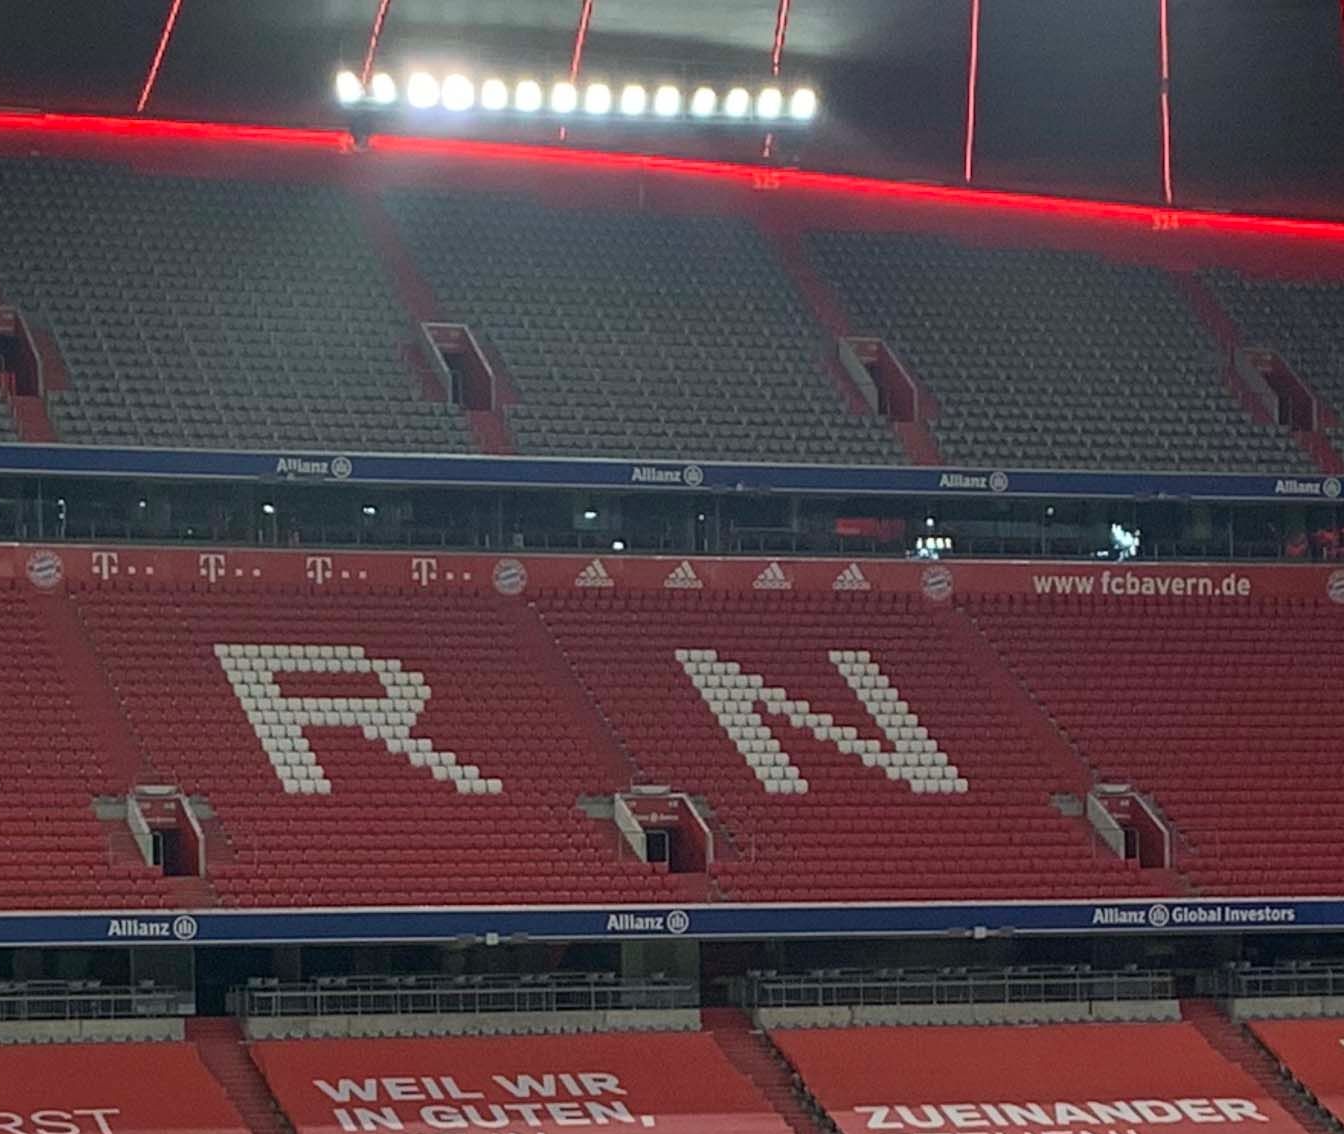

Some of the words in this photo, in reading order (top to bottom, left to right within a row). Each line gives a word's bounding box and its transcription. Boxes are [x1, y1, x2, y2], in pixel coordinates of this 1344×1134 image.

[275, 457, 329, 477] Allianz
[631, 465, 682, 484] Allianz
[939, 473, 988, 490] Allianz
[1274, 479, 1322, 496] Allianz
[606, 913, 665, 932] Allianz
[1092, 906, 1146, 925] Allianz
[1172, 906, 1223, 923] Global
[1225, 905, 1296, 923] Investors
[108, 918, 170, 937] Allianz
[313, 1076, 486, 1102] WEIL
[492, 1072, 628, 1097] WIR
[333, 1107, 404, 1132] IN
[419, 1101, 655, 1130] GUTEN,
[854, 1097, 1270, 1130] ZUEINANDER
